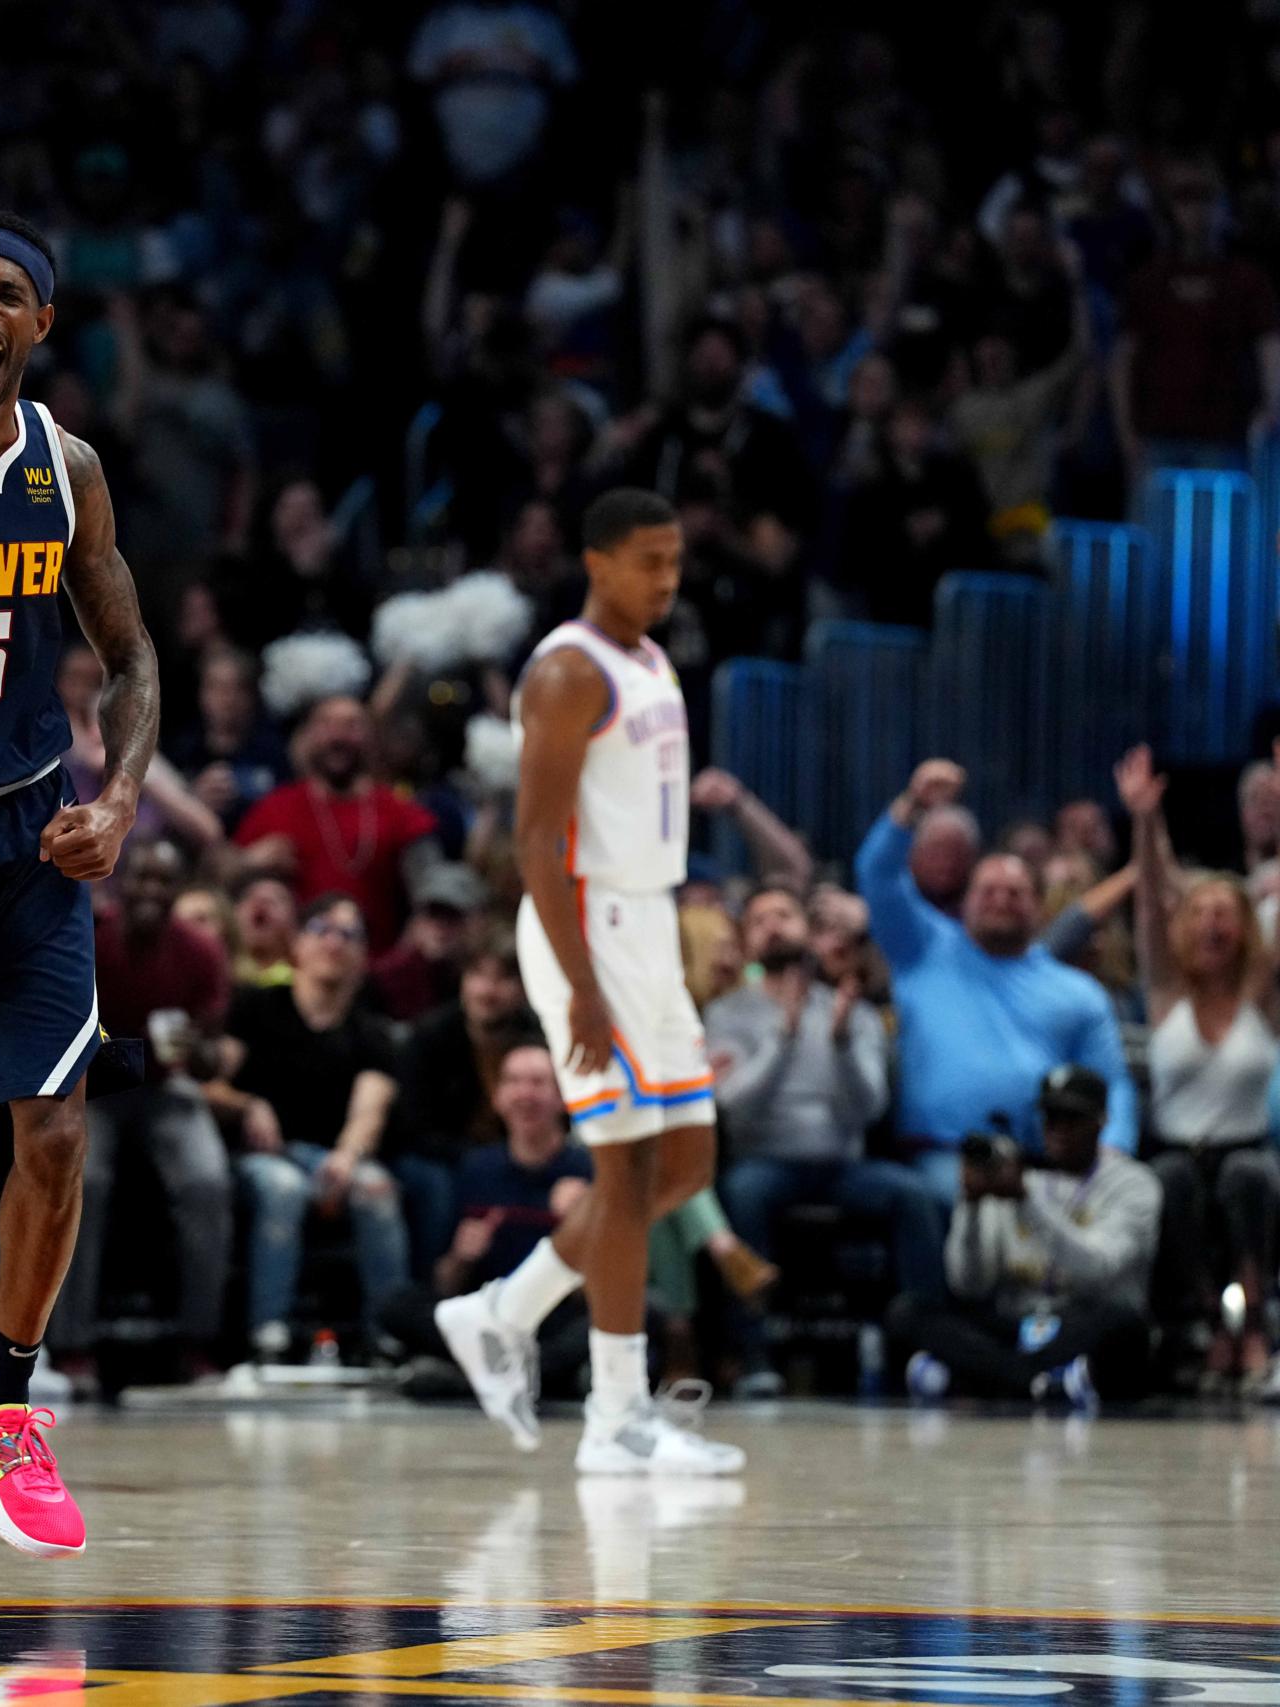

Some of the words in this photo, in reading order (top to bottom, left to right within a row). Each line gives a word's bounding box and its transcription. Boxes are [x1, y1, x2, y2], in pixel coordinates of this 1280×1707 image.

[24, 467, 52, 486] WU
[27, 487, 54, 495] Western
[31, 495, 52, 504] Union
